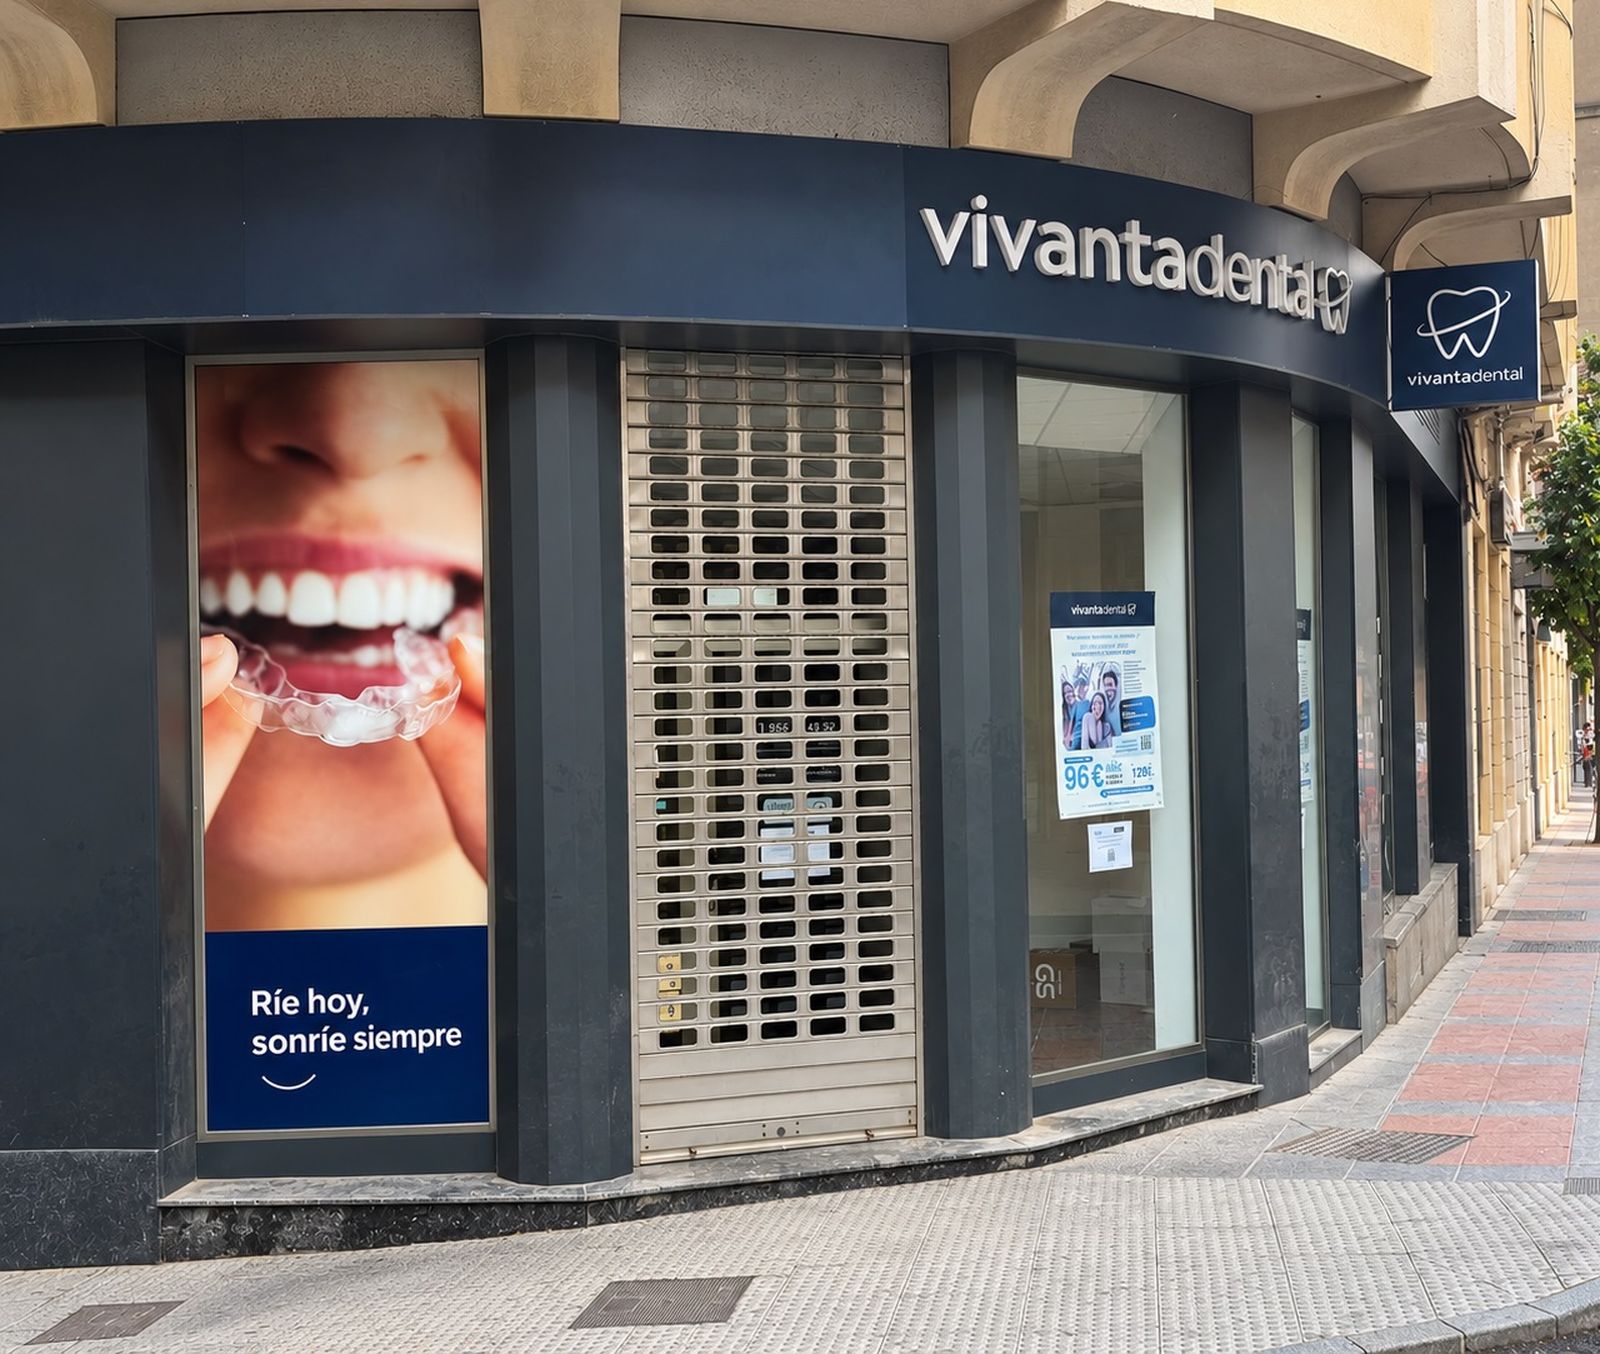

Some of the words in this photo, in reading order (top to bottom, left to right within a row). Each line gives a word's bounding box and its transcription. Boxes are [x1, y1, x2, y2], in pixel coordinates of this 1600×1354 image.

[919, 194, 1315, 320] vivantadental
[1407, 366, 1524, 386] vivantadental
[1071, 603, 1127, 615] vivantadental
[251, 988, 300, 1016] Ríe
[307, 987, 370, 1019] hoy,
[252, 1025, 347, 1055] sonríe
[353, 1024, 462, 1054] siempre
